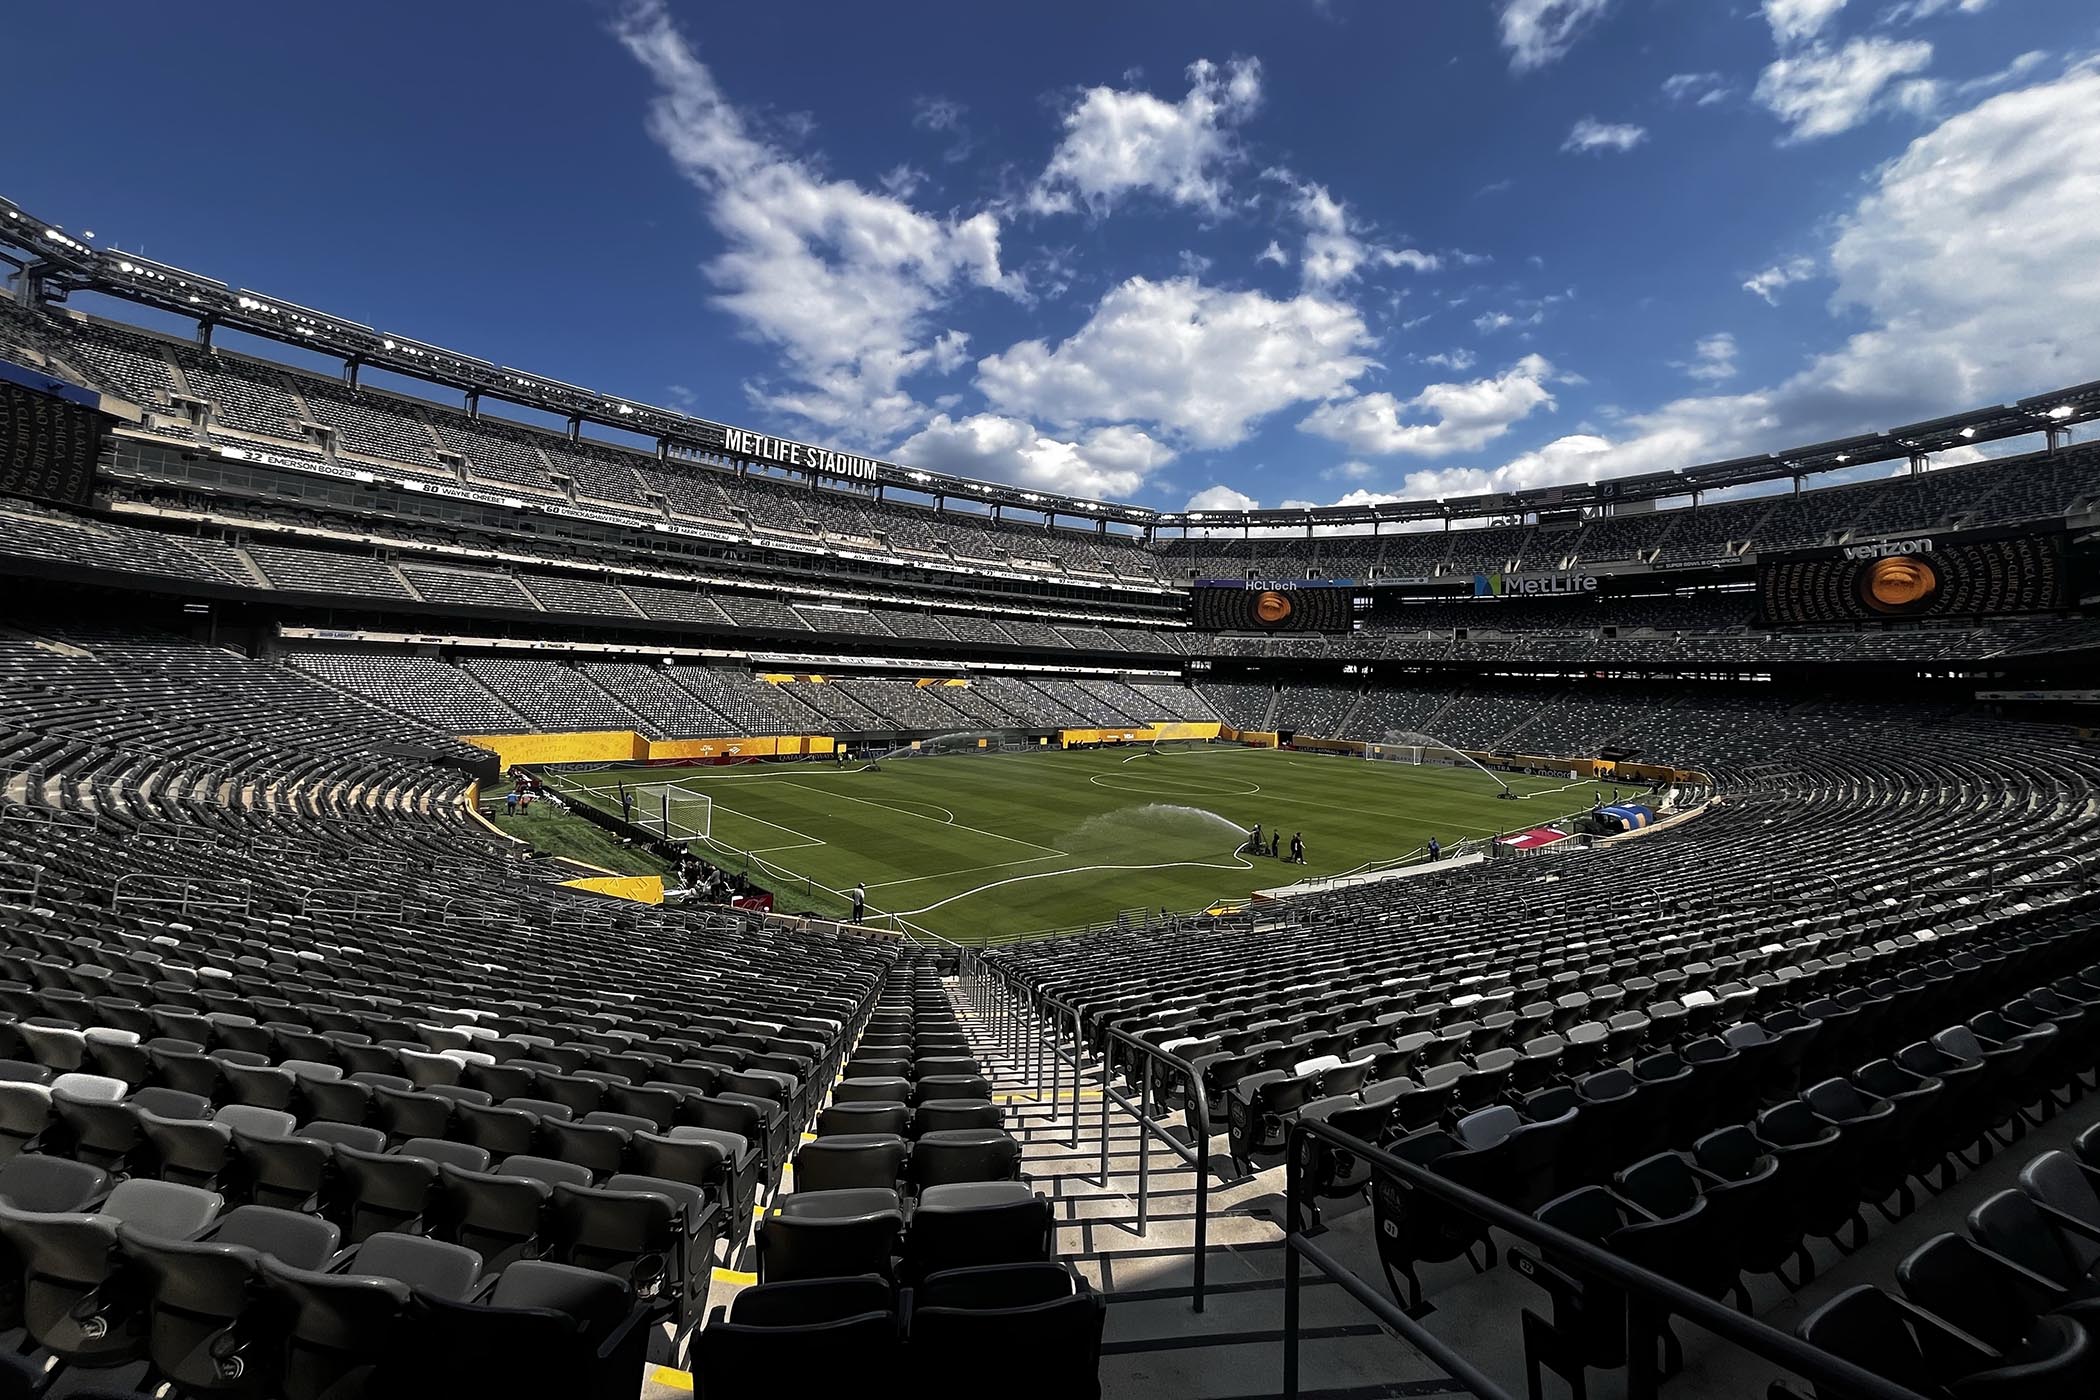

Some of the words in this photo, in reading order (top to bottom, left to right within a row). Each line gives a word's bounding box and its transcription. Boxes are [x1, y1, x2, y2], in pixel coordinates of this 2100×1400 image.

[725, 428, 800, 464] METLIFE
[806, 448, 877, 481] STADIUM
[242, 452, 262, 462] 32
[267, 456, 317, 472] EMERSON
[318, 466, 357, 479] BOOZER
[423, 484, 439, 493] 80
[442, 488, 471, 499] WAYNE
[472, 494, 506, 505] CHREBET
[545, 505, 560, 514] 60
[608, 515, 641, 527] FERGUSON
[698, 531, 730, 541] GASTINEAU
[760, 539, 771, 547] 60
[1843, 538, 1933, 560] verizon
[1706, 557, 1741, 565] CHAMPIONS
[1246, 581, 1297, 591] HCLTech
[1505, 573, 1598, 594] MetLife
[1487, 764, 1511, 772] ULTRA
[1385, 1221, 1396, 1236] 31
